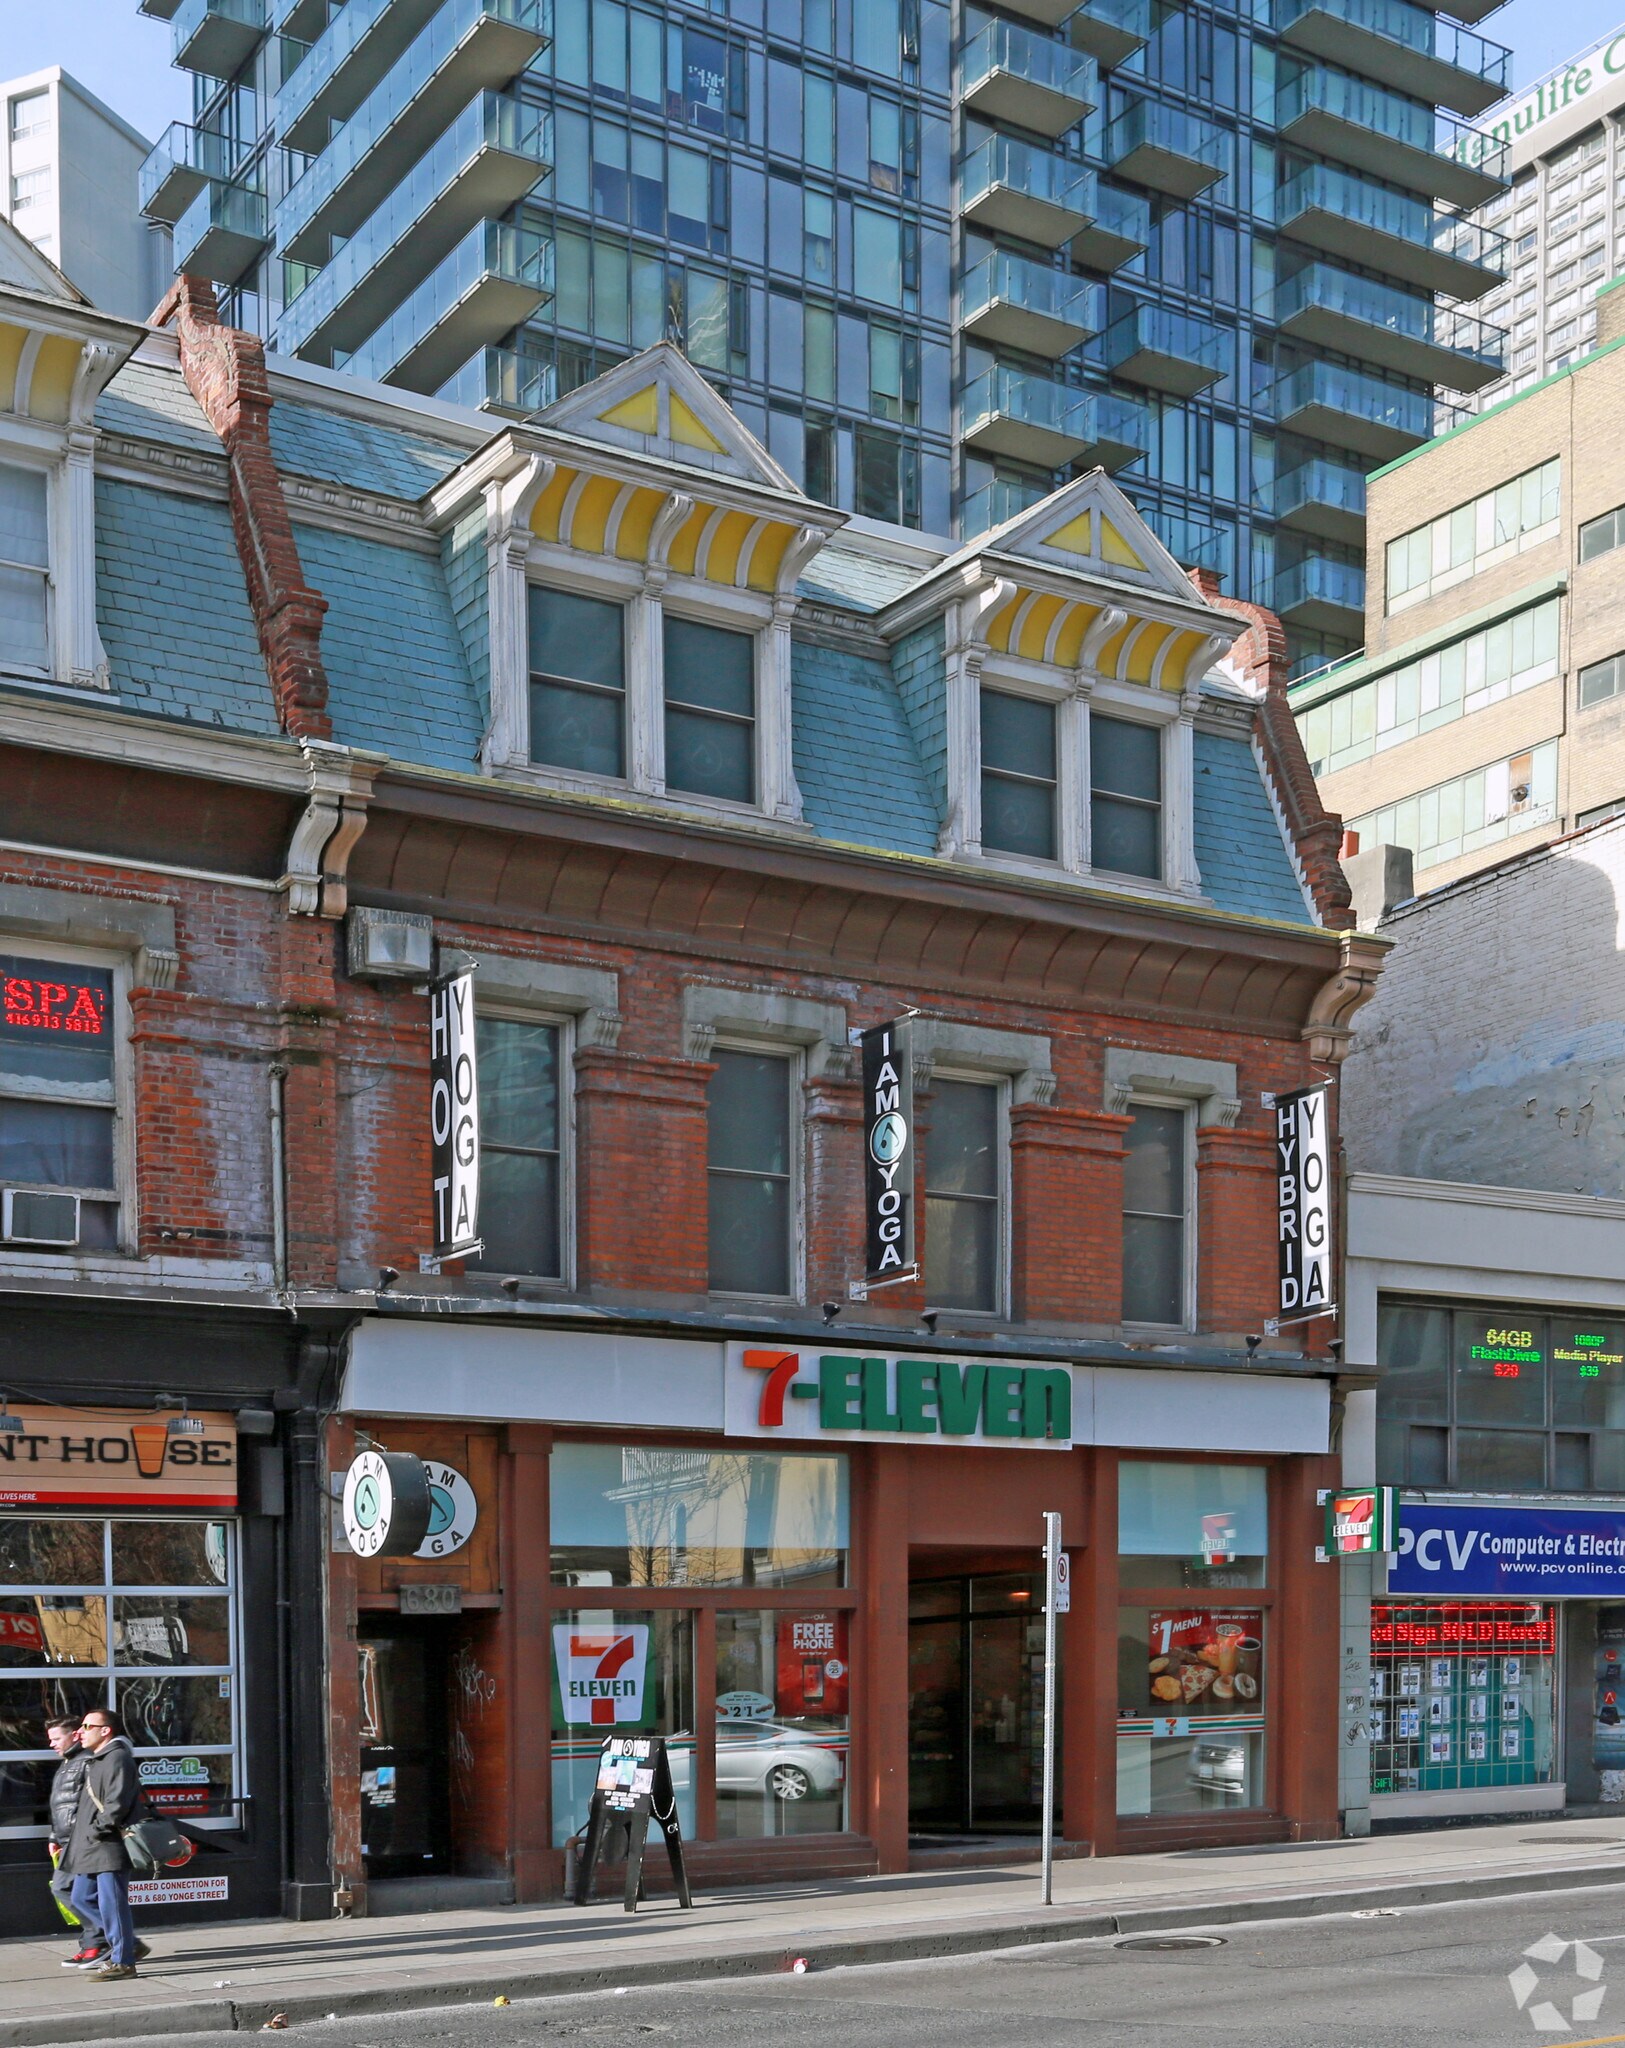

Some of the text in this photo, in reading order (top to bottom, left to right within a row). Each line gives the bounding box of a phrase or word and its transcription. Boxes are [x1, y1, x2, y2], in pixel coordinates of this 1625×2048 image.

[5, 977, 100, 1020] SPA
[65, 1017, 102, 1034] 5815
[875, 1061, 899, 1115] AM
[431, 990, 451, 1243] HOT
[452, 981, 475, 1237] YOGA
[1277, 1104, 1299, 1309] HYBRID
[1302, 1097, 1325, 1303] YOGA
[877, 1162, 902, 1270] YOGA
[1486, 1329, 1532, 1347] 64GB
[1554, 1348, 1624, 1365] Media Player
[1579, 1365, 1600, 1378] $39
[349, 1517, 388, 1552] YOGA
[1388, 1528, 1625, 1571] PCV Computer & Electr
[406, 1588, 456, 1611] 680
[793, 1622, 834, 1639] FREE
[1172, 1616, 1202, 1633] MENU
[1441, 1622, 1492, 1640] SOLD
[793, 1639, 834, 1649] PHONE
[570, 1635, 634, 1725] 7
[141, 1759, 196, 1775] order it
[1375, 1777, 1392, 1788] GIFT
[129, 1879, 225, 1892] SHARED CONNECTION FOR
[129, 1895, 142, 1903] 678
[152, 1894, 167, 1902] 680
[168, 1892, 194, 1901] YONGE
[196, 1890, 226, 1899] STREET
